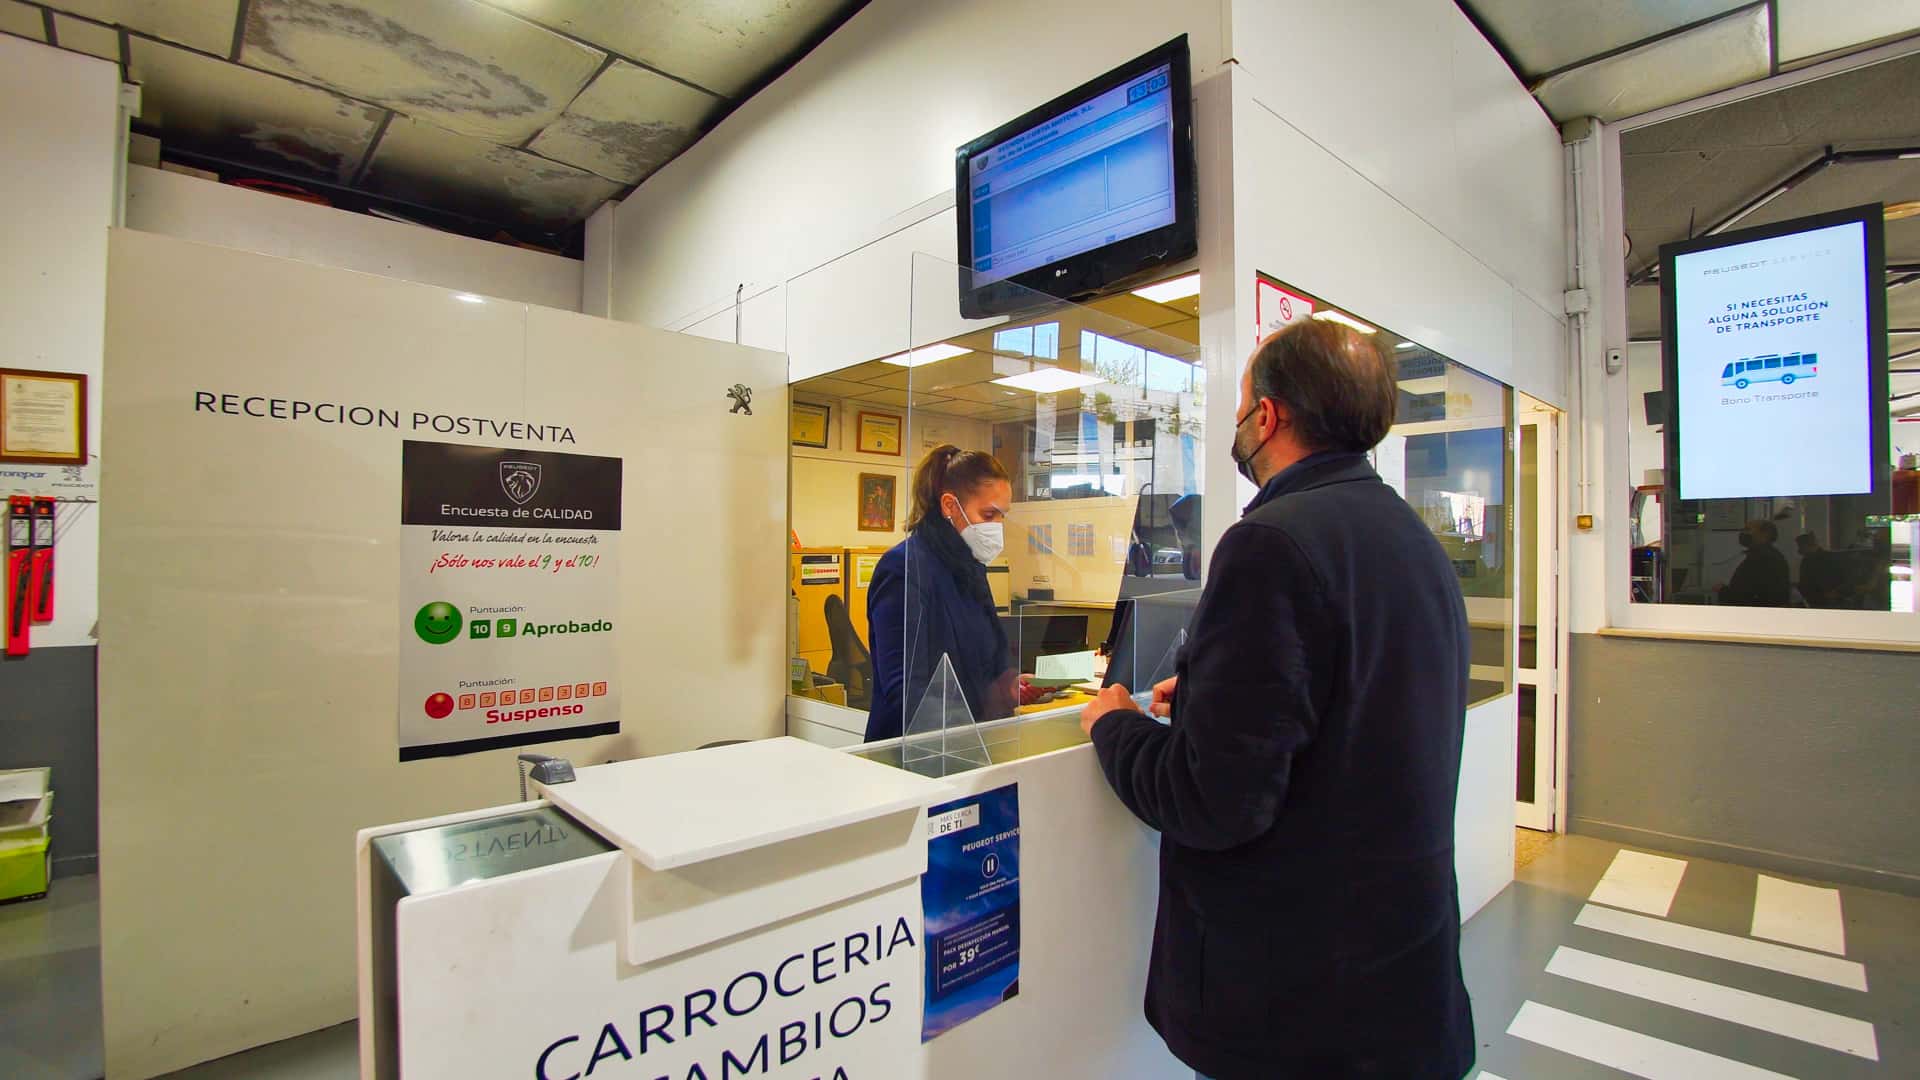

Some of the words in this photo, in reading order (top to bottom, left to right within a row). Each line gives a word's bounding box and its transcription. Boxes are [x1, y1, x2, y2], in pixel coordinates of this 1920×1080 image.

[1703, 260, 1768, 276] PEUGEOT
[1741, 292, 1808, 308] NECESITAS
[1708, 311, 1758, 324] ALGUNA
[1717, 325, 1732, 334] DE
[1736, 313, 1821, 331] TRANSPORTE
[1721, 397, 1752, 406] Bono
[1753, 391, 1819, 403] Transporte
[195, 391, 399, 429] RECEPCION
[412, 412, 576, 444] POSTVENTA
[441, 504, 509, 518] Encuesta
[512, 508, 530, 518] de
[532, 507, 593, 520] CALIDAD
[432, 529, 469, 543] Valora
[472, 530, 484, 543] la
[486, 531, 525, 544] calidad
[527, 535, 541, 544] en
[542, 532, 553, 544] la
[555, 534, 599, 545] encuesta
[430, 553, 468, 574] ¡Sólo
[472, 557, 495, 568] nos
[498, 554, 525, 568] vale
[528, 554, 542, 568] el
[542, 554, 552, 570] 9
[553, 559, 563, 573] y
[565, 554, 578, 568] el
[470, 605, 525, 614] Puntuación:
[473, 624, 488, 635] 10
[522, 619, 613, 638] Aprobado
[459, 677, 514, 689] Puntuación:
[486, 704, 584, 724] Suspenso
[940, 823, 952, 833] DE
[955, 819, 962, 829] TI
[962, 837, 994, 853] PEUGEOT
[943, 963, 957, 974] POR
[535, 916, 916, 1080] CARROCERIA
